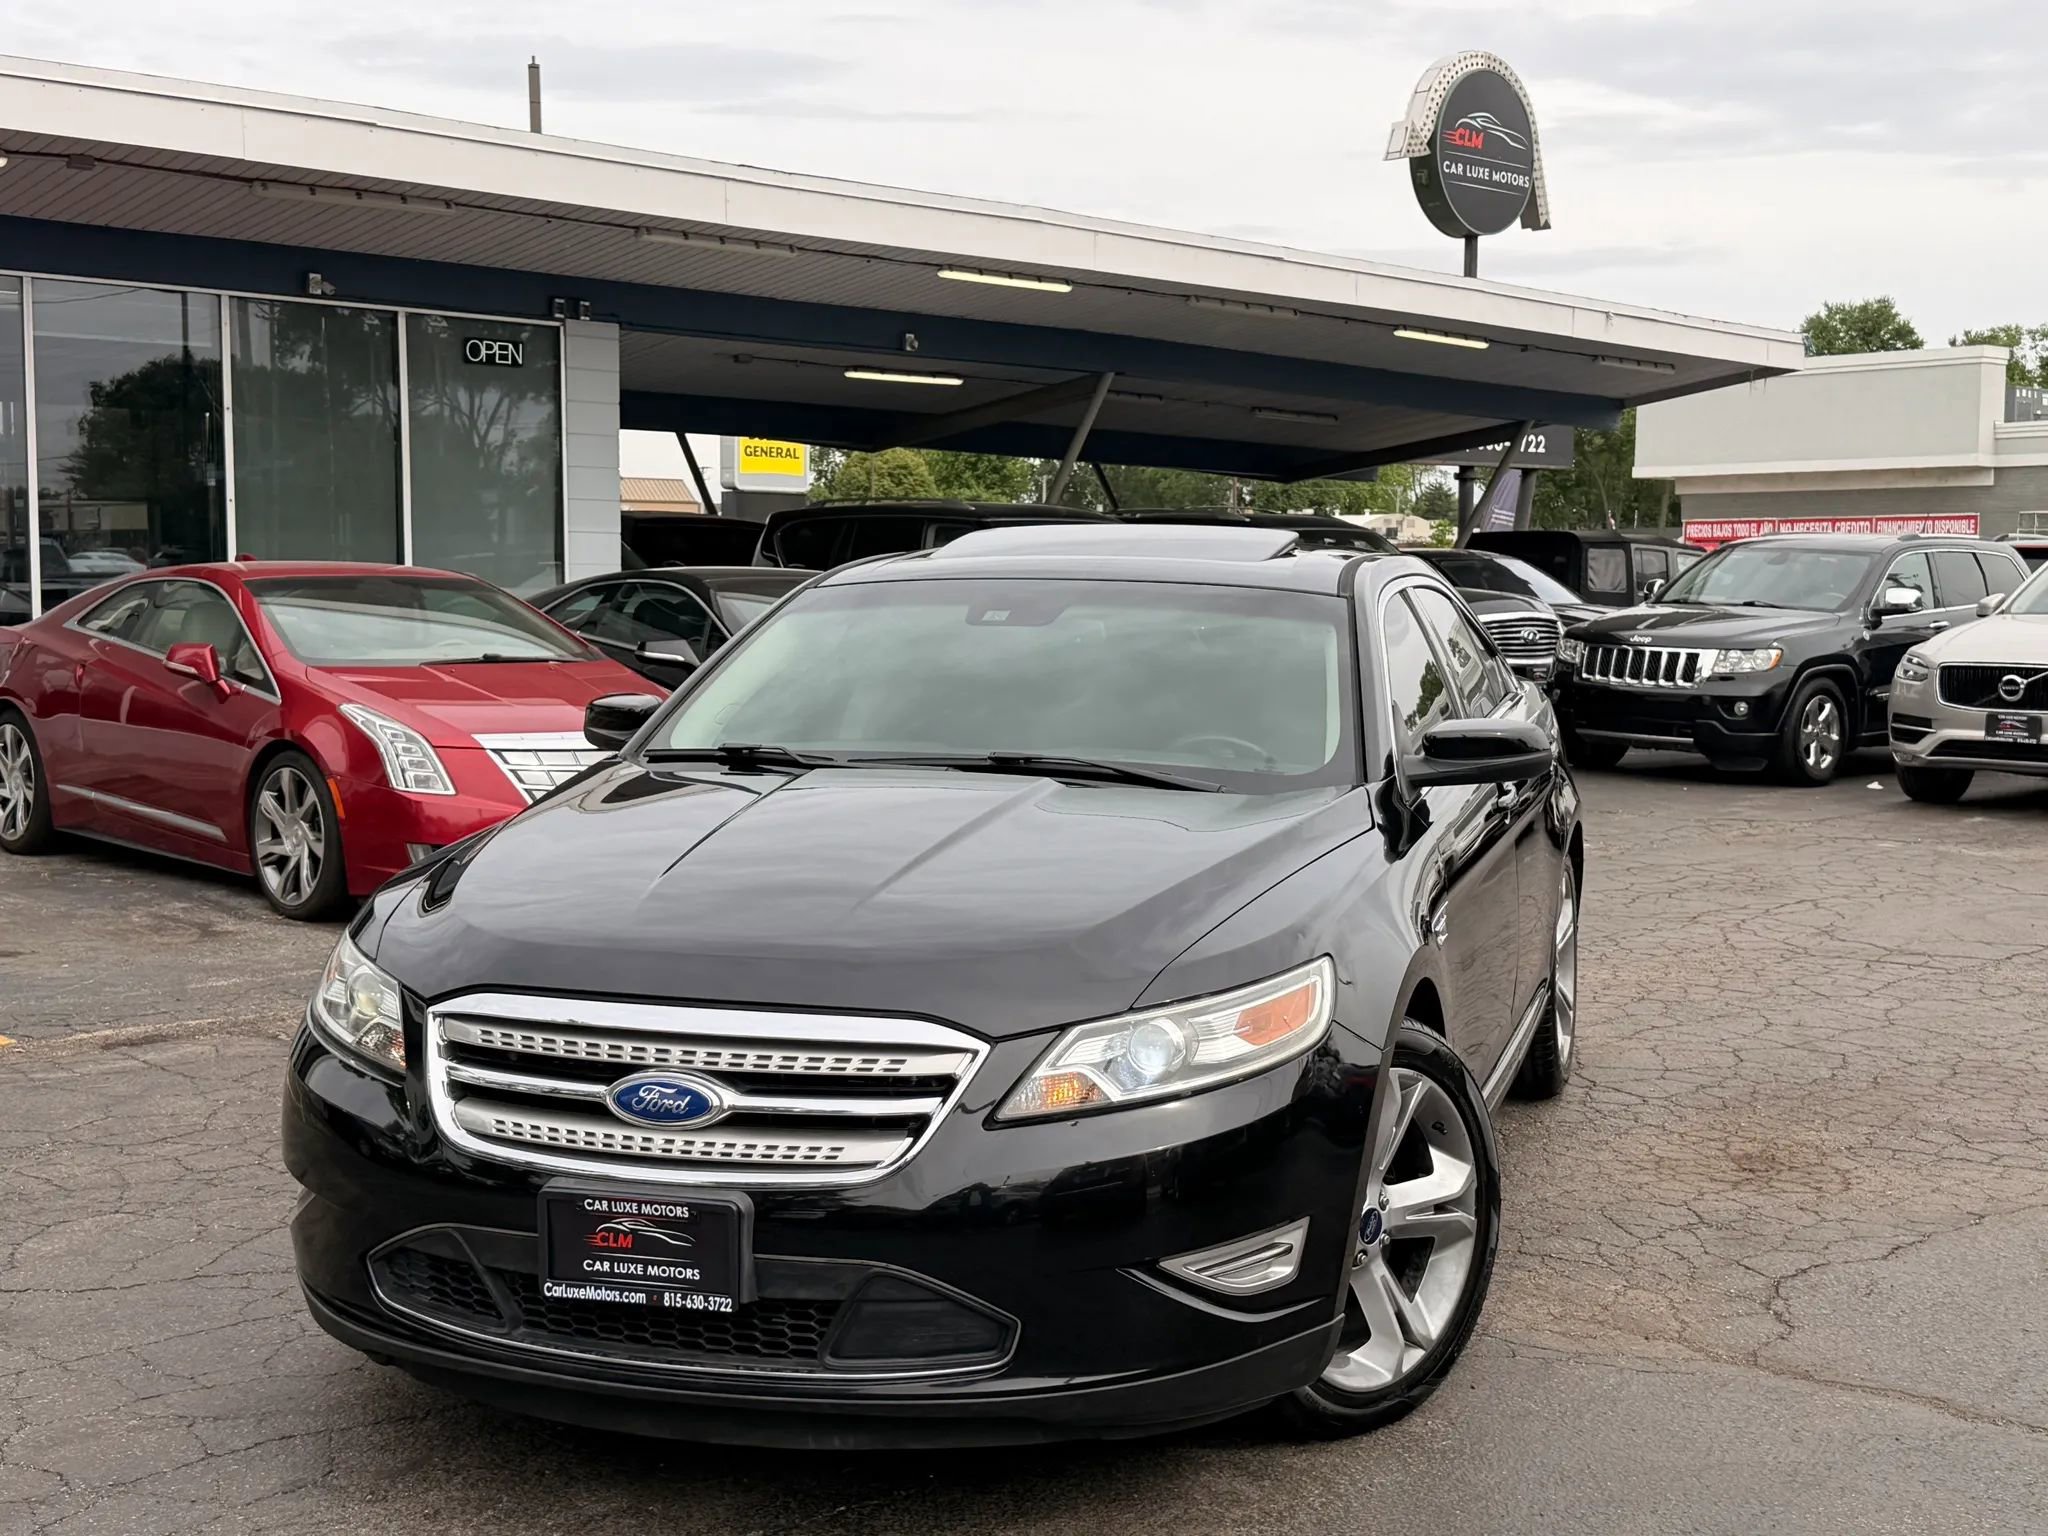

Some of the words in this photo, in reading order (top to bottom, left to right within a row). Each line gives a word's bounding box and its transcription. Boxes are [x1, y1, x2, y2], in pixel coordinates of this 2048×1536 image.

[1455, 128, 1484, 149] CLM
[1443, 160, 1464, 176] CAR
[1466, 164, 1490, 180] LUXE
[1492, 170, 1530, 188] MOTORS
[466, 339, 523, 365] OPEN
[744, 445, 800, 460] GENERAL
[1686, 523, 1712, 538] PRECIOS
[1712, 523, 1731, 538] BAJOS
[1733, 523, 1750, 537] TODO
[1750, 522, 1758, 537] EL
[1934, 518, 1976, 534] DISPONIBLE
[632, 1084, 692, 1115] Ford
[584, 1199, 609, 1212] CAR
[611, 1201, 639, 1214] LUXE
[641, 1203, 689, 1218] MOTORS
[596, 1231, 633, 1249] CLM
[583, 1259, 611, 1272] CAR
[614, 1262, 644, 1275] LUXE
[647, 1265, 700, 1280] MOTORS
[544, 1282, 647, 1305] CarLuxeMotors.com
[663, 1291, 733, 1313] 815-630-3722
